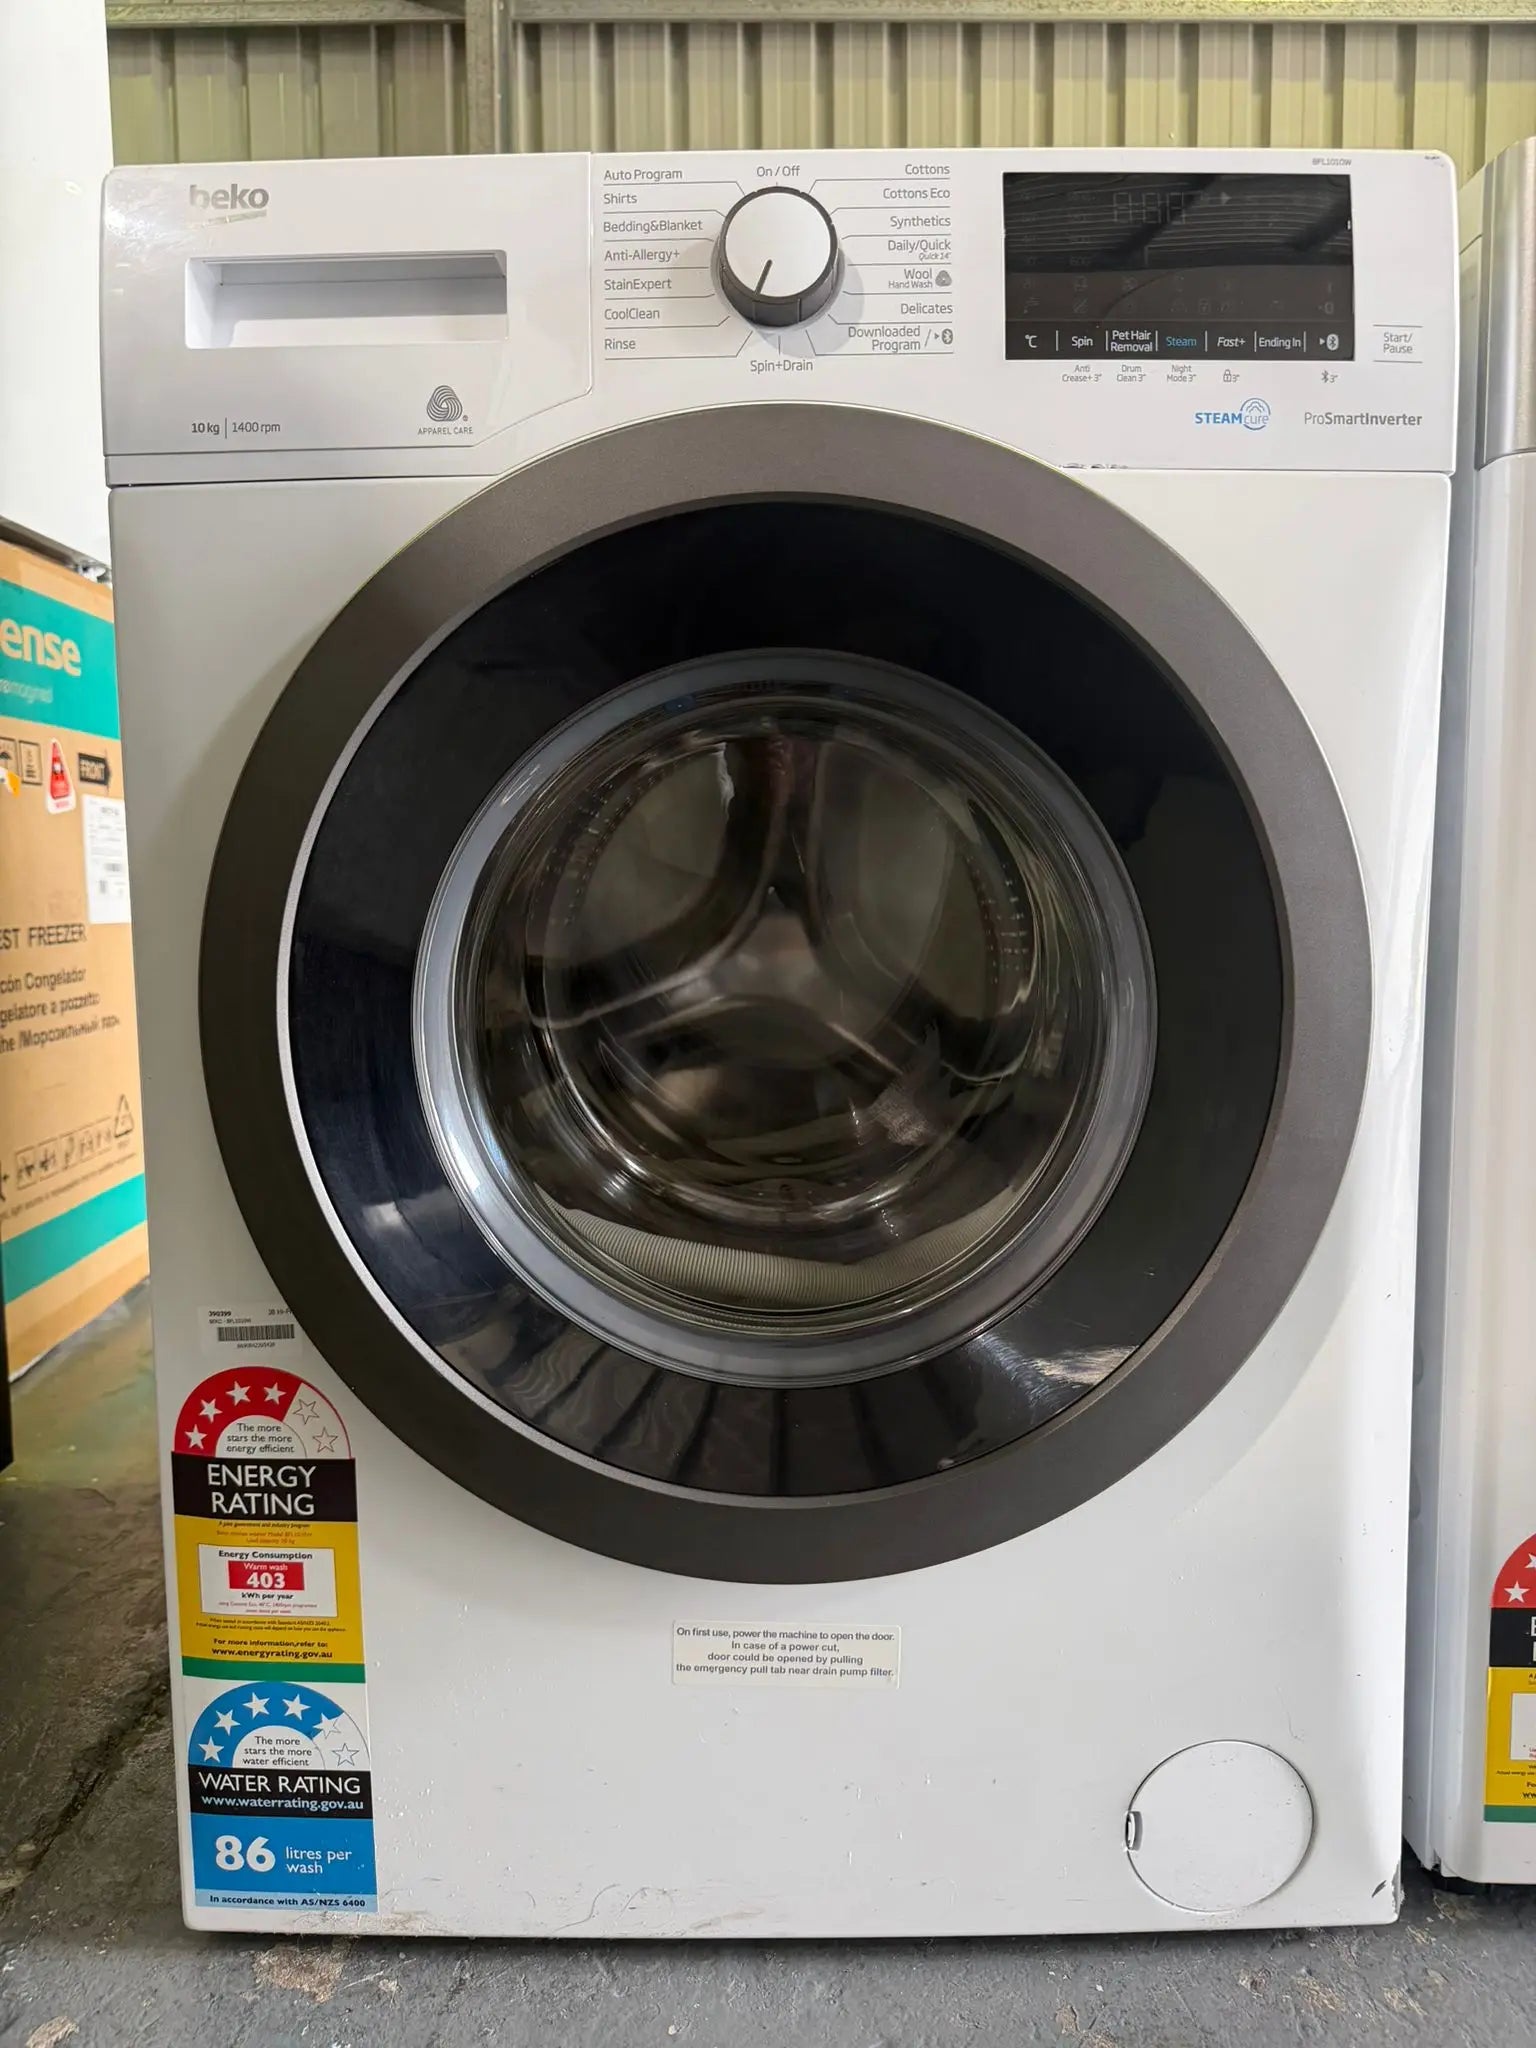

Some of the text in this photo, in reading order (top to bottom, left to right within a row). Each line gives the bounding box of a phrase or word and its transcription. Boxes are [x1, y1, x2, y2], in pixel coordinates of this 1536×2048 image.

[604, 169, 682, 181] Auto Program
[756, 166, 772, 177] On
[783, 165, 800, 177] Off
[904, 164, 950, 175] Cottons
[189, 183, 269, 209] beko
[604, 193, 637, 204] Shirts
[883, 188, 951, 199] Cottons Eco
[604, 220, 703, 233] Bedding&Blanket
[890, 215, 951, 228] Synthetics
[888, 240, 951, 252] Daily/Quick
[604, 249, 680, 263] Anti-Allergy+
[904, 269, 933, 279] Wool
[604, 278, 672, 291] StainExpert
[888, 280, 933, 288] Hand Wash
[604, 308, 660, 319] CoolClean
[901, 303, 953, 314] Delicates
[848, 326, 920, 338] Downloaded
[1112, 329, 1151, 341] Pet Hair
[1383, 331, 1413, 343] Start/
[604, 338, 636, 349] Rinse
[872, 340, 921, 351] Program
[1071, 335, 1093, 348] Spin
[1111, 341, 1153, 352] Removal
[1166, 336, 1197, 348] Steam
[1217, 336, 1245, 348] Fast+
[1259, 336, 1301, 350] Ending In
[1383, 343, 1413, 354] Pause
[750, 359, 813, 373] Spin+Drain
[1074, 365, 1091, 373] Anti
[1121, 364, 1142, 373] Drum
[1171, 364, 1192, 375] Night
[1062, 374, 1093, 383] Crease+
[1117, 373, 1136, 382] Clean
[1167, 373, 1187, 382] Mode
[1304, 412, 1422, 426] ProSmartInverter
[191, 422, 220, 435] 10 kg
[232, 422, 281, 435] 1400 rpm
[418, 427, 452, 435] APPAREL
[29, 924, 87, 948] FREEZER
[237, 1423, 281, 1432] The more
[251, 1434, 266, 1442] the
[227, 1445, 294, 1454] energy efficient
[207, 1463, 317, 1487] ENERGY
[212, 1493, 315, 1516] RATING
[219, 1550, 313, 1560] Energy Consumption
[269, 1563, 288, 1571] wash
[247, 1573, 285, 1588] 403
[677, 1627, 895, 1641] On first use, power the machine to open the door.
[212, 1648, 332, 1659] www.energyrating.gov.au
[769, 1642, 778, 1650] of
[789, 1644, 818, 1652] power
[821, 1644, 840, 1653] cut,
[708, 1653, 863, 1665] door could be opened by pulling
[676, 1664, 894, 1677] the emergency pull tab near drain pump filter.
[255, 1736, 272, 1745] The
[244, 1747, 267, 1755] stars
[272, 1757, 309, 1766] efficient
[198, 1772, 360, 1794] WATER RATING
[201, 1795, 364, 1811] www.waterrating.gov.au
[215, 1835, 275, 1872] 86
[286, 1847, 352, 1863] litres per
[287, 1862, 323, 1874] wash
[210, 1895, 365, 1907] In accordance with AS/NZS 6400
